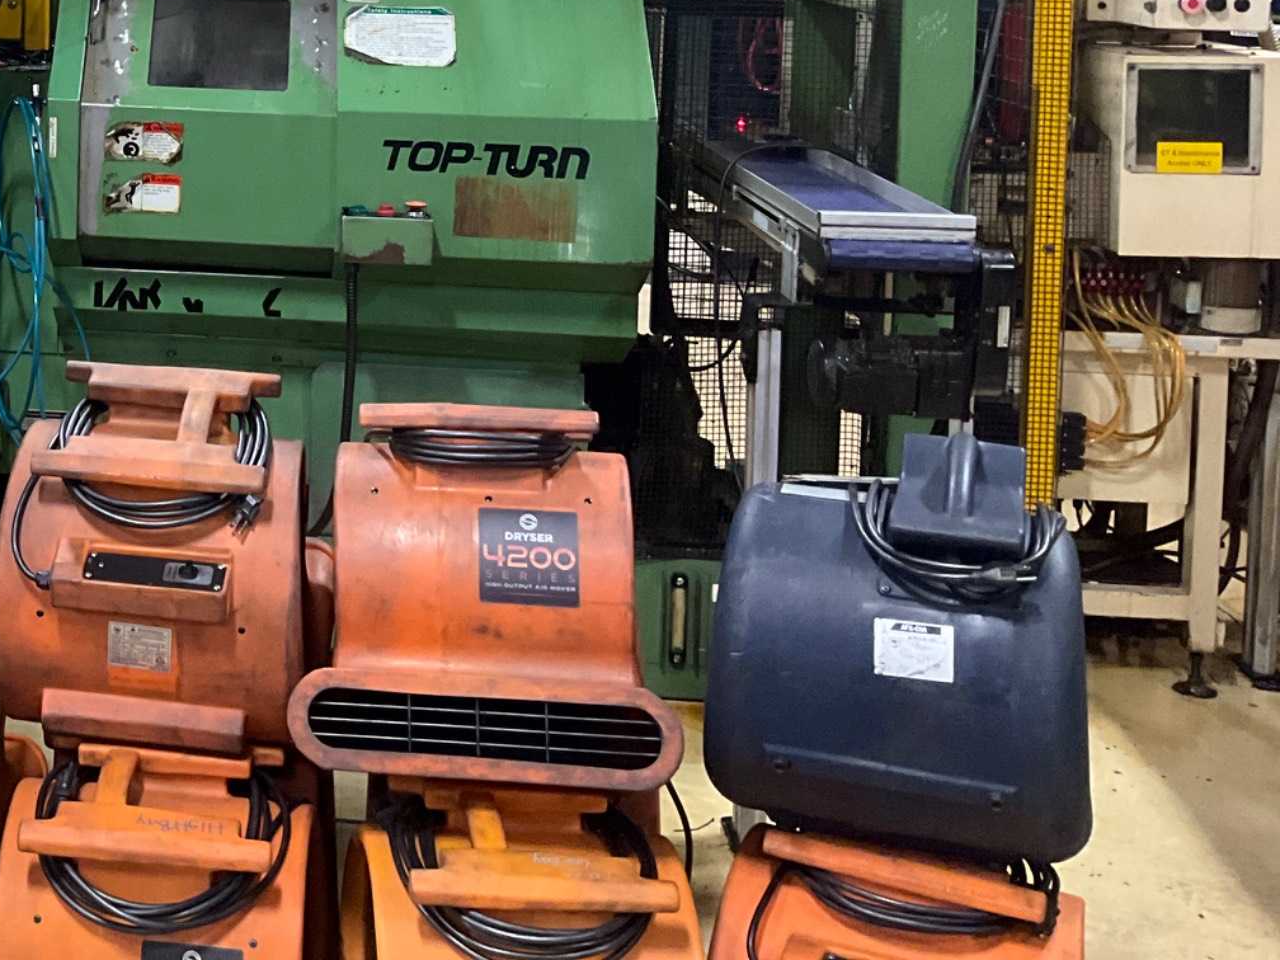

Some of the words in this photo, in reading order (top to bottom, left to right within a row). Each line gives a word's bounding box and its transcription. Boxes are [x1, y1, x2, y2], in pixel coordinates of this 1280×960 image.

[383, 139, 591, 180] TOP-TURN
[504, 531, 554, 543] DRYSER
[483, 543, 576, 571] 4200
